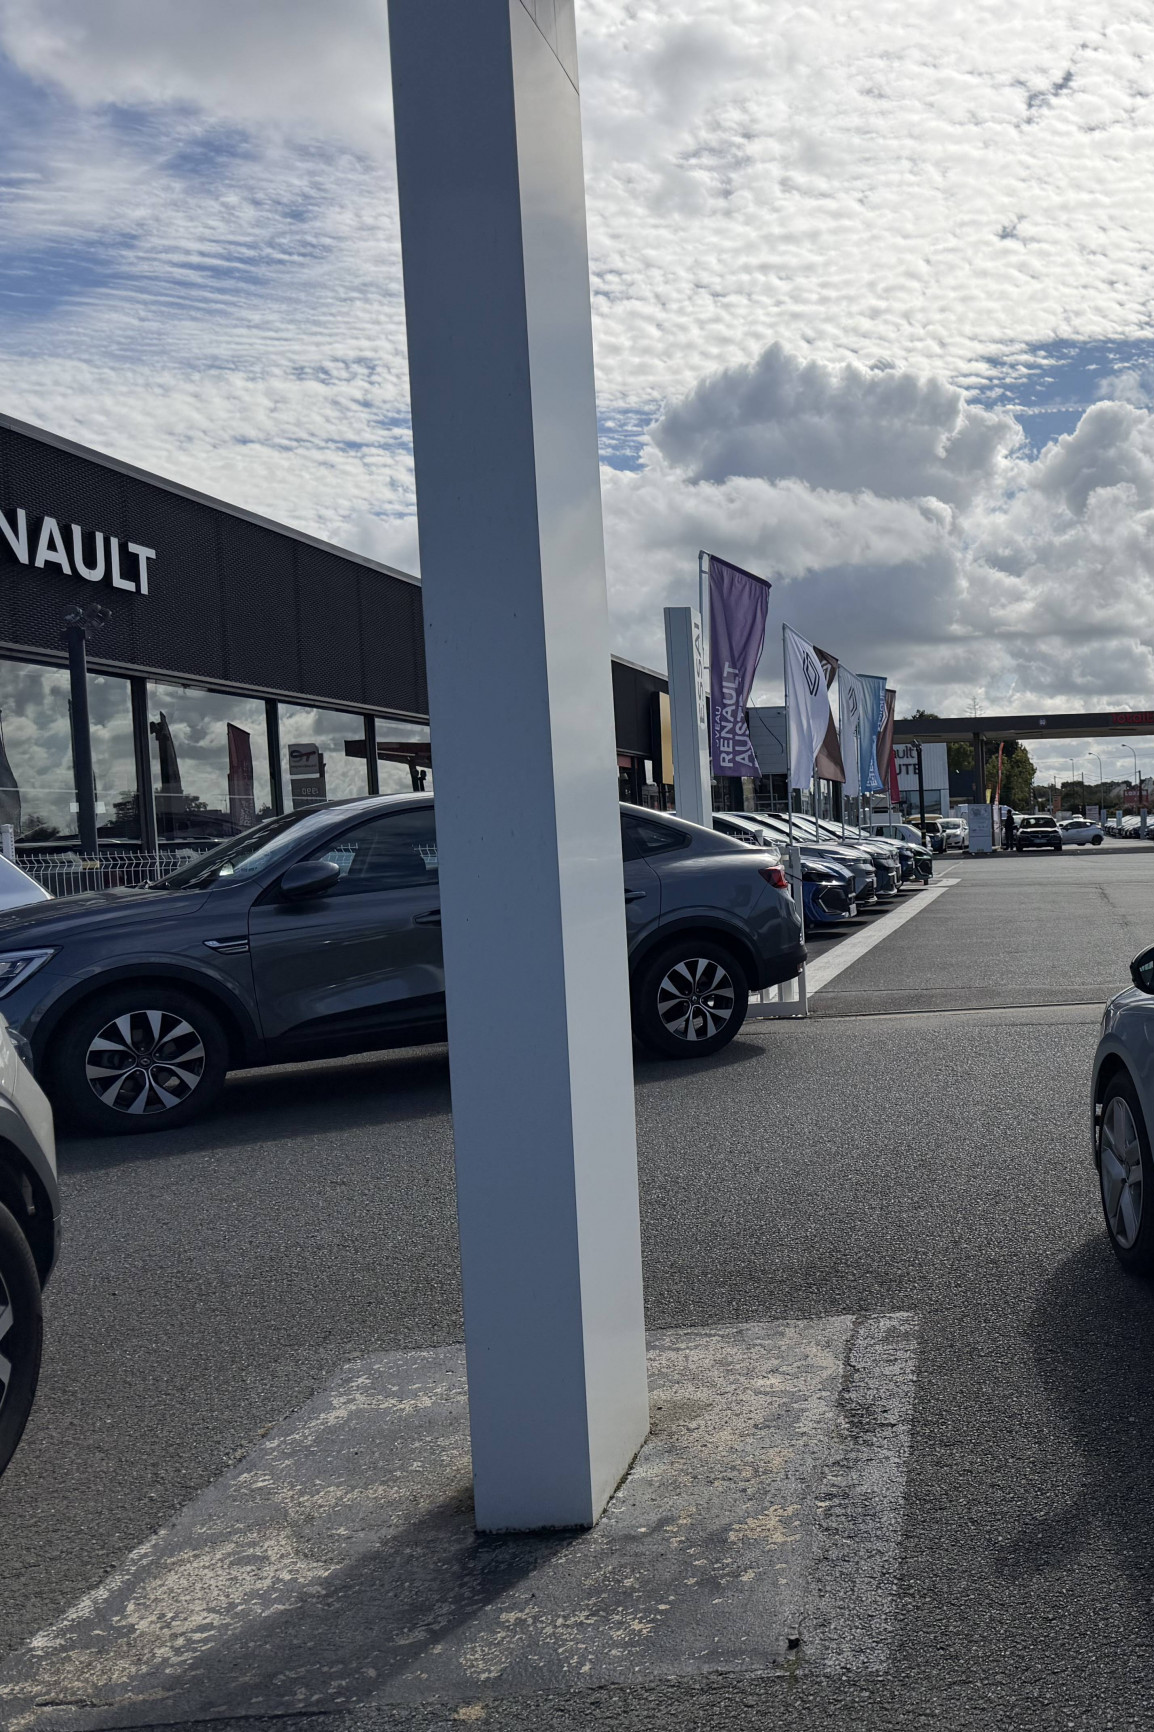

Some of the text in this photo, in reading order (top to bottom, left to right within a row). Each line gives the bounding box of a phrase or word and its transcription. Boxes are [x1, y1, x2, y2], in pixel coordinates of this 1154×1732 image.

[0, 507, 157, 596] NAULT
[694, 622, 705, 724] ESSAI
[720, 661, 739, 767] RENAULT
